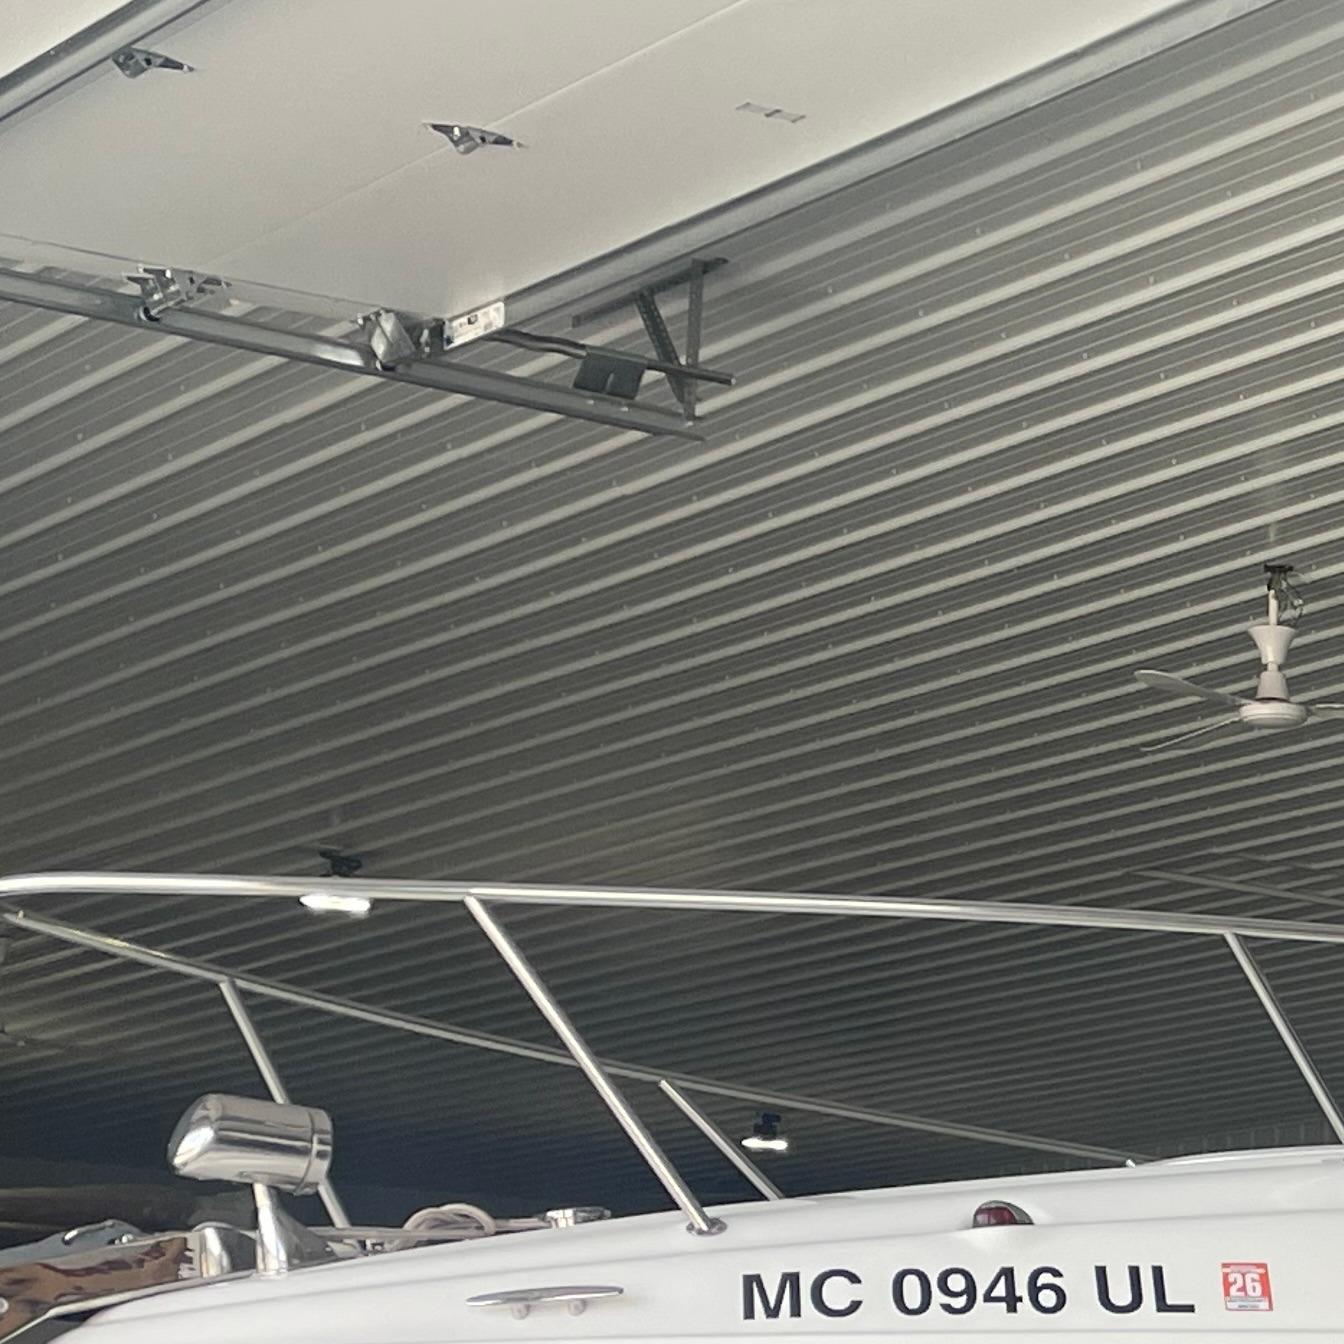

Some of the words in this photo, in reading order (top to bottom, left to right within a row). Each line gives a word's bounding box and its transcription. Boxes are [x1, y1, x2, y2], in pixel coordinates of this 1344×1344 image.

[742, 1268, 862, 1319] MC
[892, 1266, 1066, 1315] 0946
[1094, 1265, 1195, 1313] UL
[1227, 1271, 1263, 1298] 26
